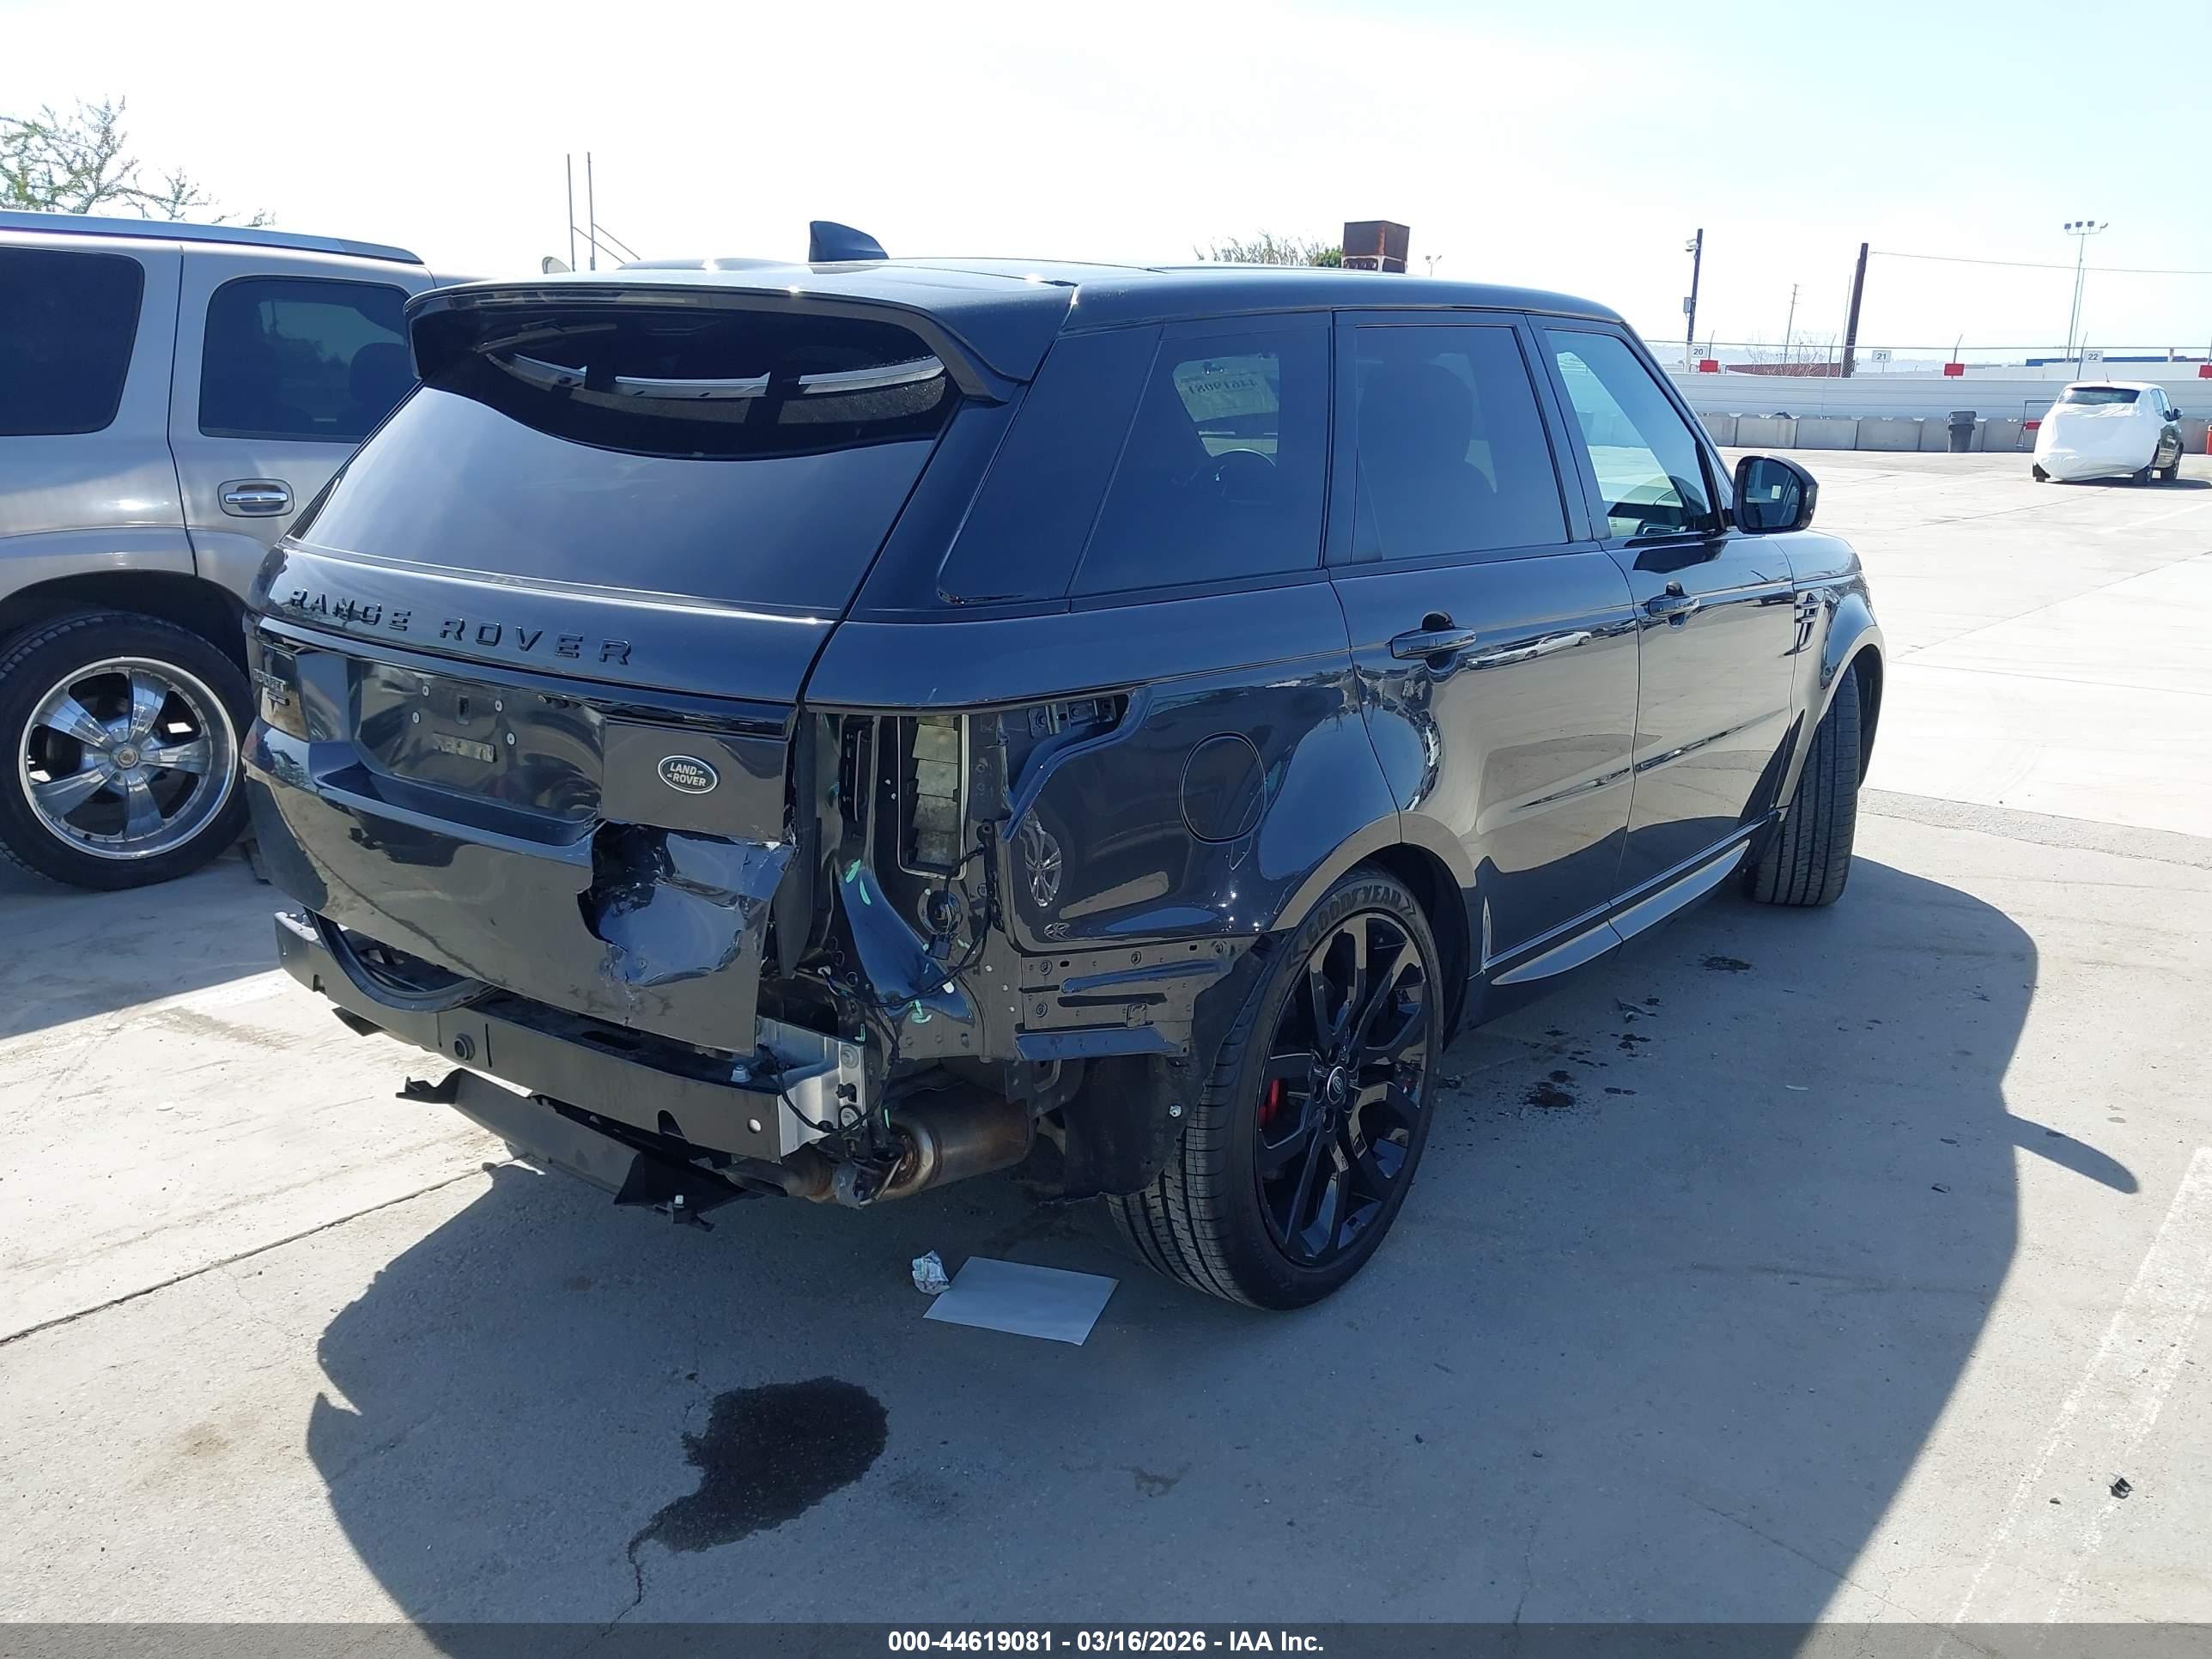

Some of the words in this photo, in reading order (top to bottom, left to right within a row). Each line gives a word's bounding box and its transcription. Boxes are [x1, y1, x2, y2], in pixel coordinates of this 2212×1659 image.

[1692, 348, 1705, 356] 20
[289, 588, 412, 632] RANGE
[439, 617, 634, 666] ROVER
[670, 762, 697, 775] LAND
[672, 773, 707, 787] ROVER
[1305, 884, 1402, 943] GOODYEAR
